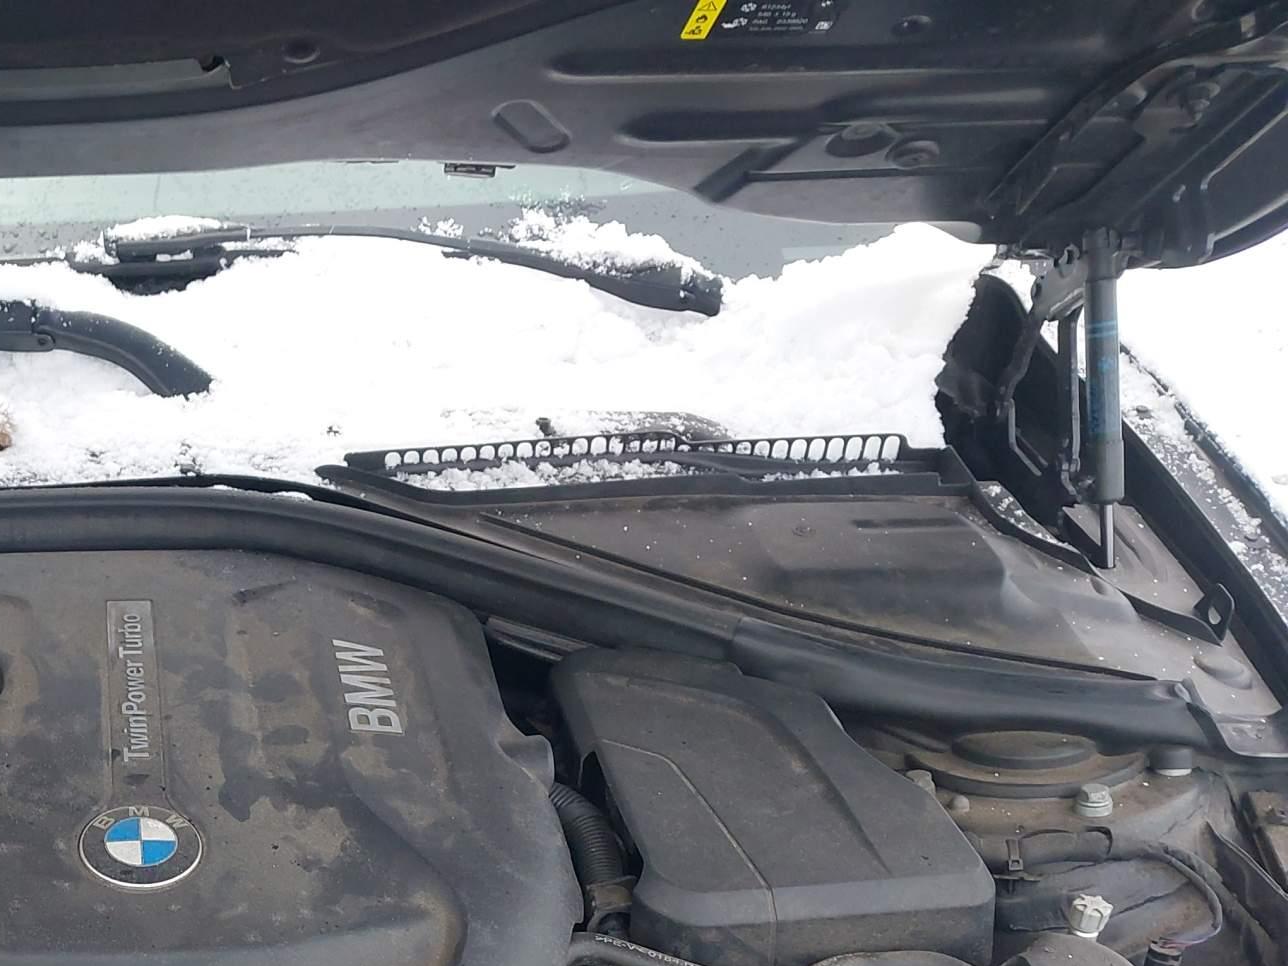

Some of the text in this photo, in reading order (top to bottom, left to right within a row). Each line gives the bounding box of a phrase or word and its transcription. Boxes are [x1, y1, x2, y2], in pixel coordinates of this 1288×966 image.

[118, 611, 150, 762] TwinPower Turbo
[330, 638, 404, 735] BMW
[92, 805, 189, 830] BMW
